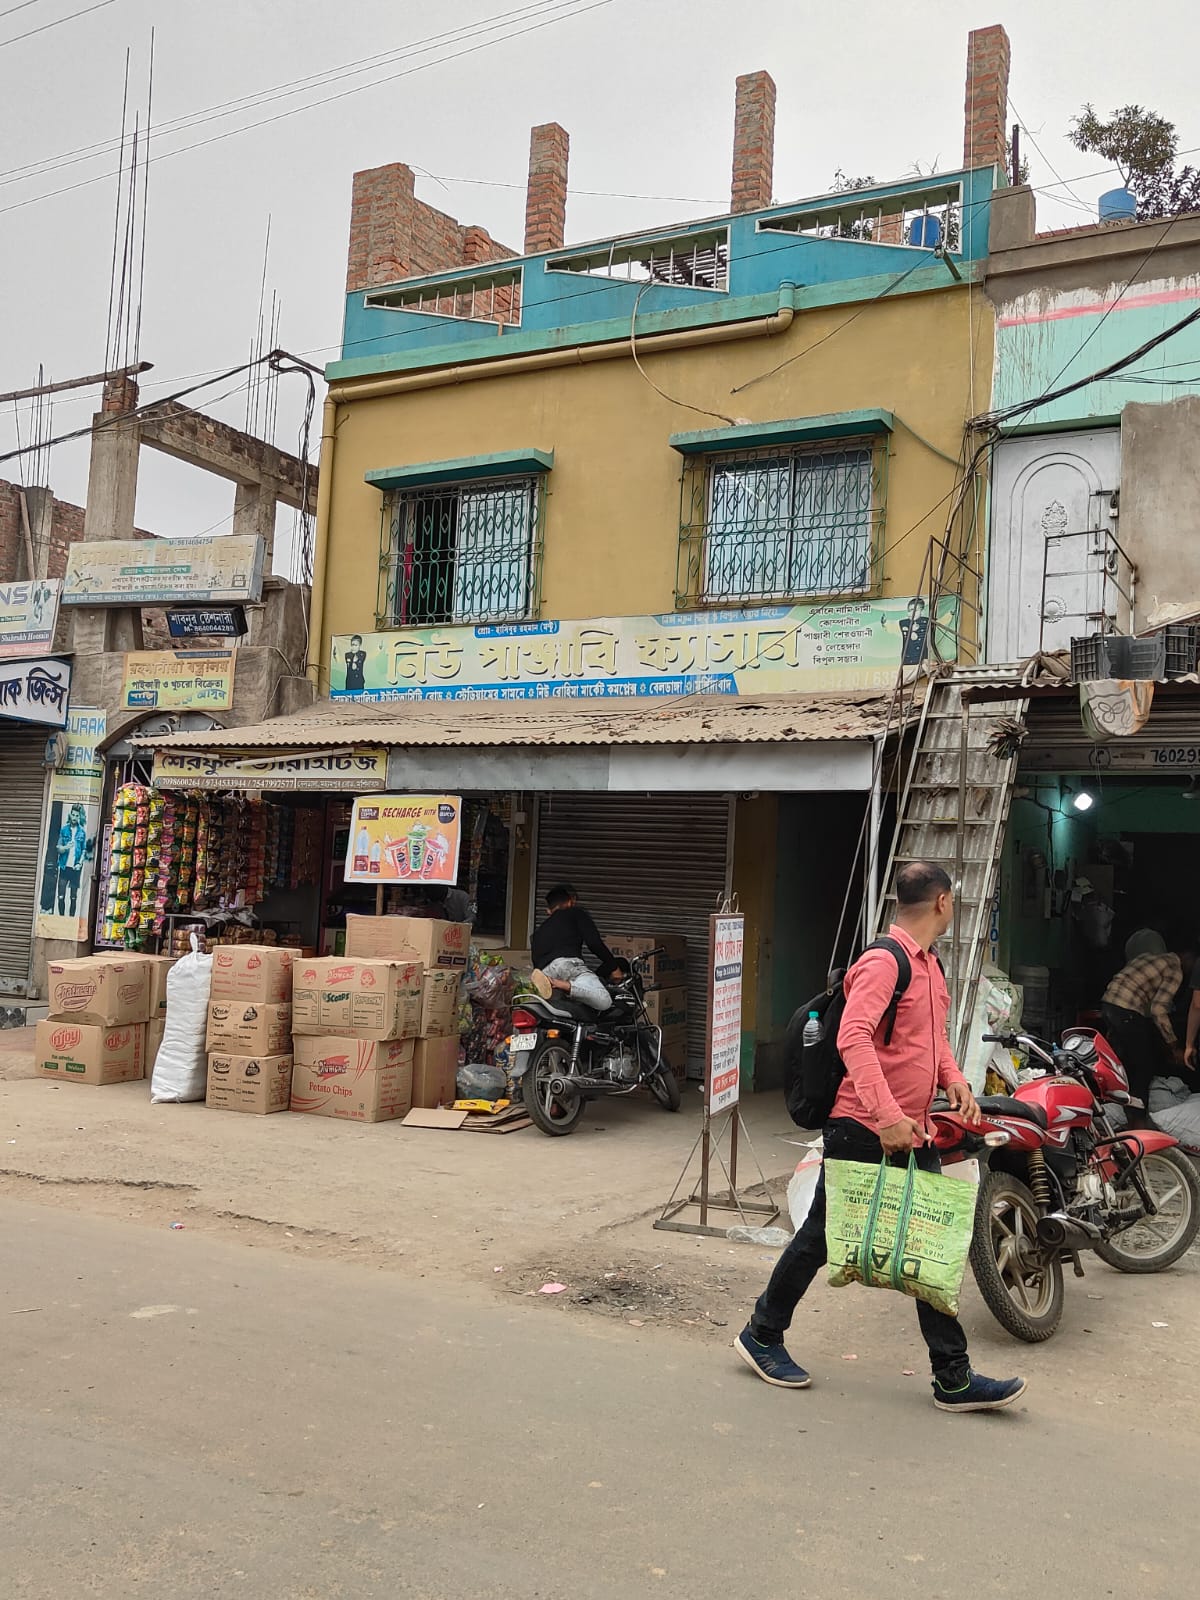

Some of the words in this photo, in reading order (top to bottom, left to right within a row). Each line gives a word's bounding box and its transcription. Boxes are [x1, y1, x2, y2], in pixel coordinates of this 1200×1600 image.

[854, 602, 871, 613] দামী
[387, 635, 464, 685] নিউ
[813, 655, 835, 666] বিপুল
[536, 681, 549, 698] নিউ
[66, 746, 102, 765] EANS
[382, 807, 423, 818] RECHARGE
[309, 1081, 331, 1093] Potato
[332, 1085, 353, 1097] Chips
